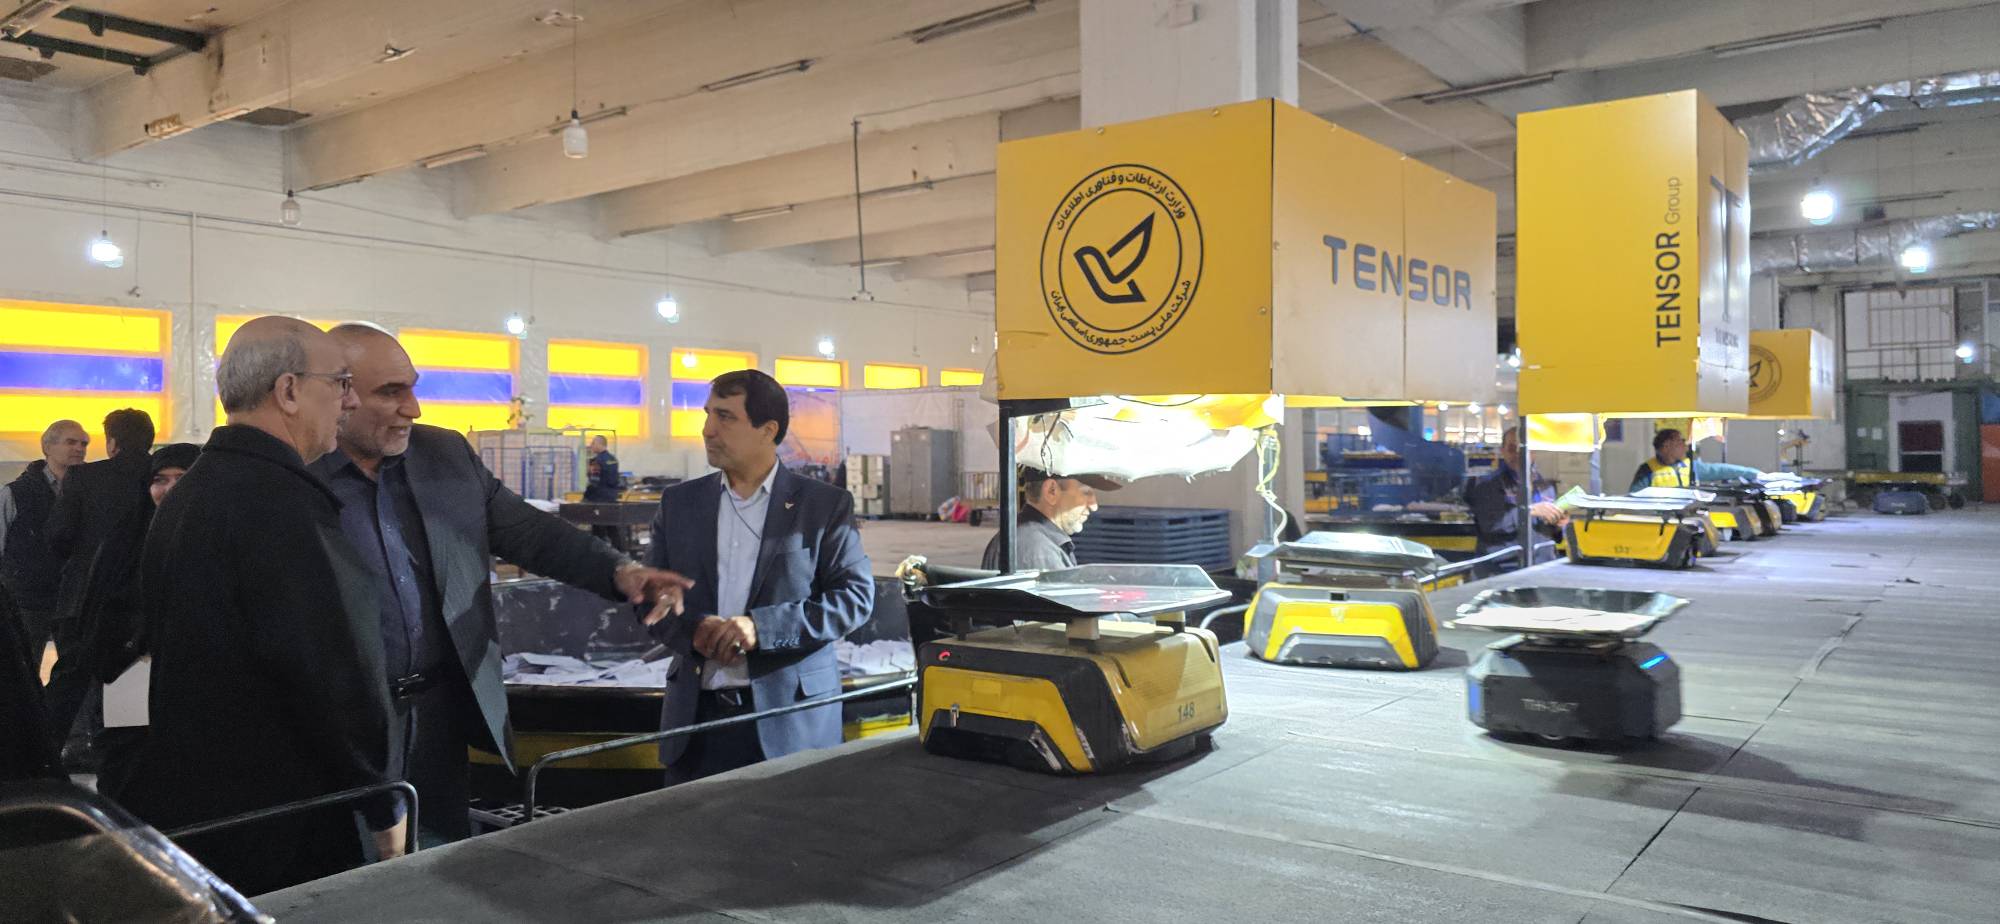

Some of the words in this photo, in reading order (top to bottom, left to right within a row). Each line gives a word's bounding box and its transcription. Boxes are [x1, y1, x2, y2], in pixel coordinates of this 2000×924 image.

[1085, 171, 1117, 198] فناوری
[1117, 173, 1124, 186] و
[1125, 172, 1168, 195] ارتباطات
[1057, 192, 1086, 231] اطلاعات
[1165, 191, 1186, 220] وزارت
[1665, 177, 1683, 225] Group
[1322, 234, 1473, 311] TENSOR
[1051, 290, 1066, 312] ایران
[1171, 280, 1191, 313] شرکت
[1656, 231, 1681, 348] TENSOR
[1155, 311, 1173, 332] ملی
[1086, 334, 1127, 348] جمهوری
[1128, 326, 1156, 343] پست
[1177, 701, 1196, 722] 148
